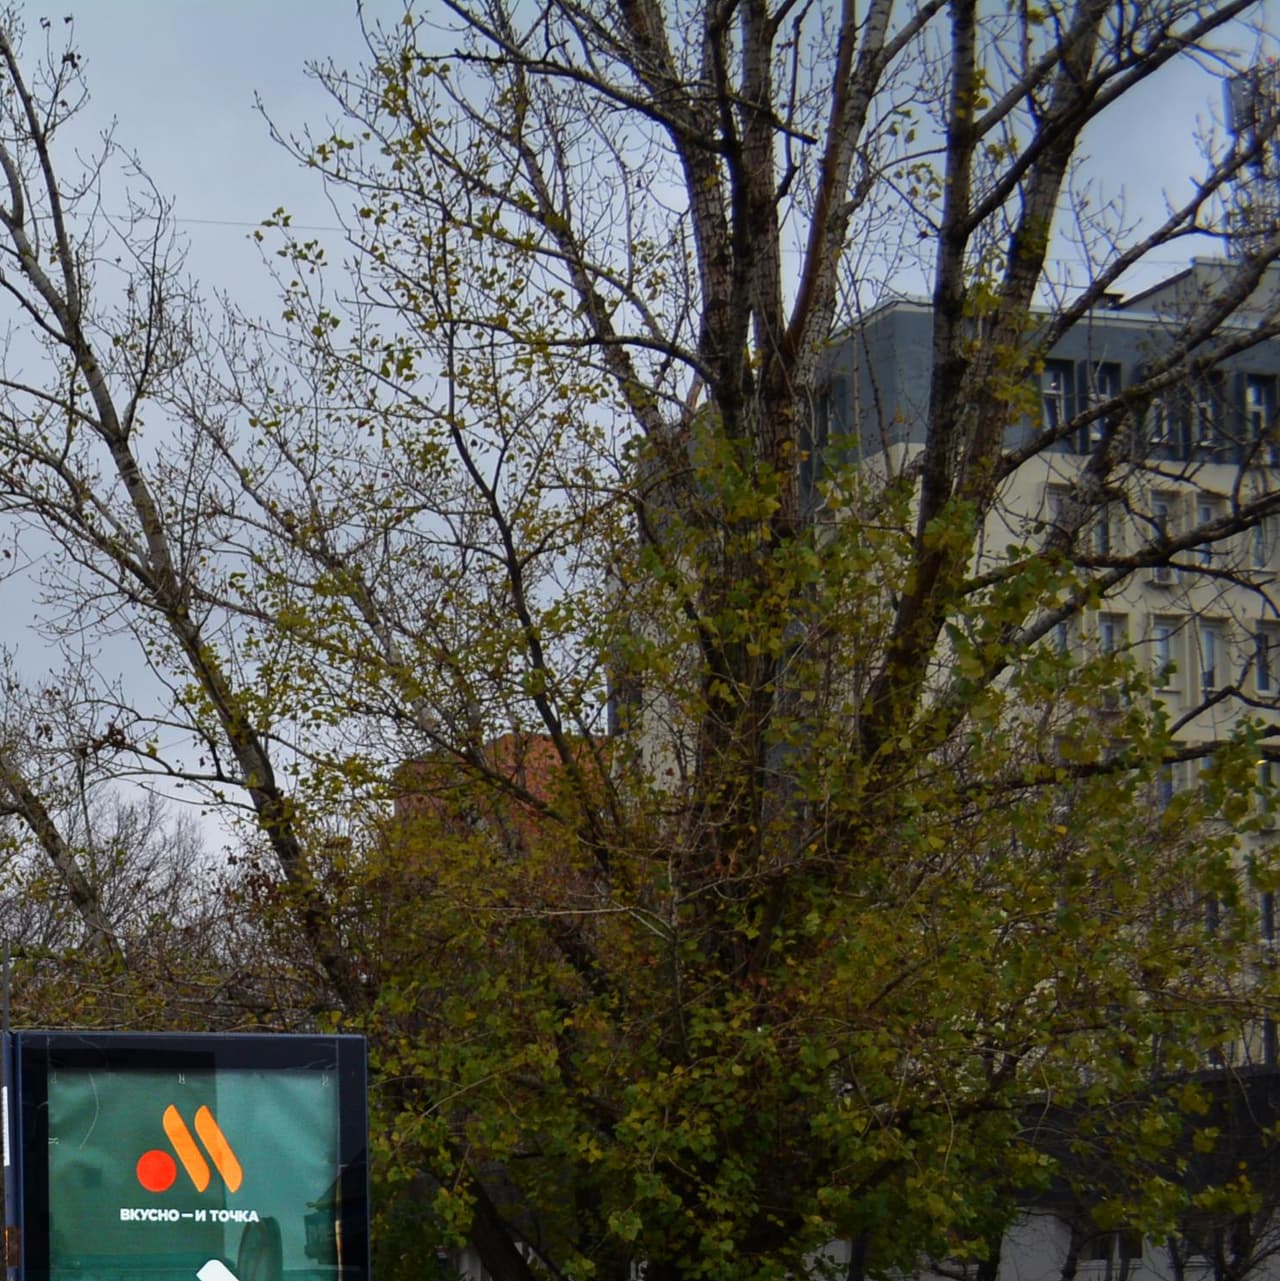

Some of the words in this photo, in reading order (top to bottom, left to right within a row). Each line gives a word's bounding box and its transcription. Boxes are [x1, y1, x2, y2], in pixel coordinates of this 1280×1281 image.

[120, 1208, 179, 1221] ВКУСНО
[195, 1210, 206, 1221] И
[209, 1210, 259, 1222] ТОЧКА
